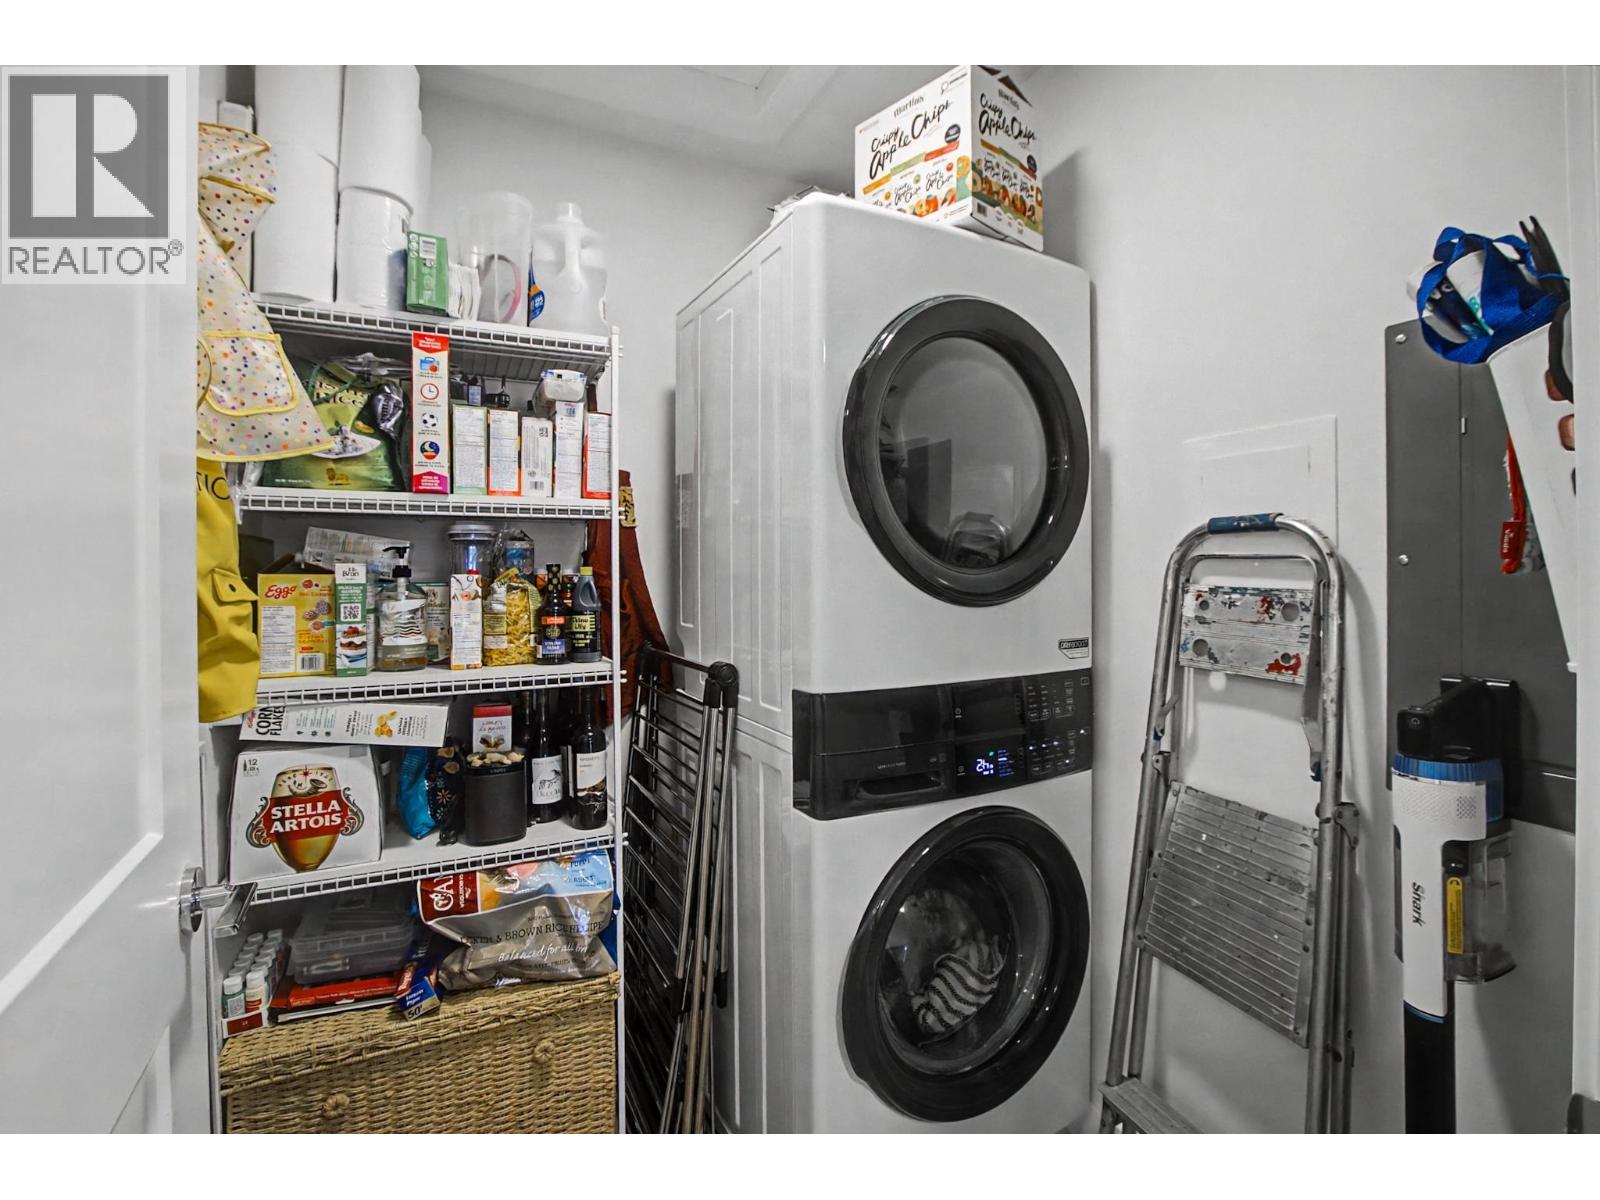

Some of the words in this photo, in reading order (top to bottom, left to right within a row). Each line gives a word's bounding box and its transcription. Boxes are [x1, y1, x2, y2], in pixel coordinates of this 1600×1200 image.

[869, 131, 912, 180] Apple
[911, 100, 952, 139] Chips
[871, 127, 900, 153] Crispy
[265, 584, 297, 600] Eggo
[248, 758, 258, 766] 12
[270, 800, 342, 820] STELLA
[270, 814, 342, 834] ARTOIS
[1411, 881, 1426, 928] Shark
[505, 924, 544, 941] BROWN
[543, 944, 560, 962] for
